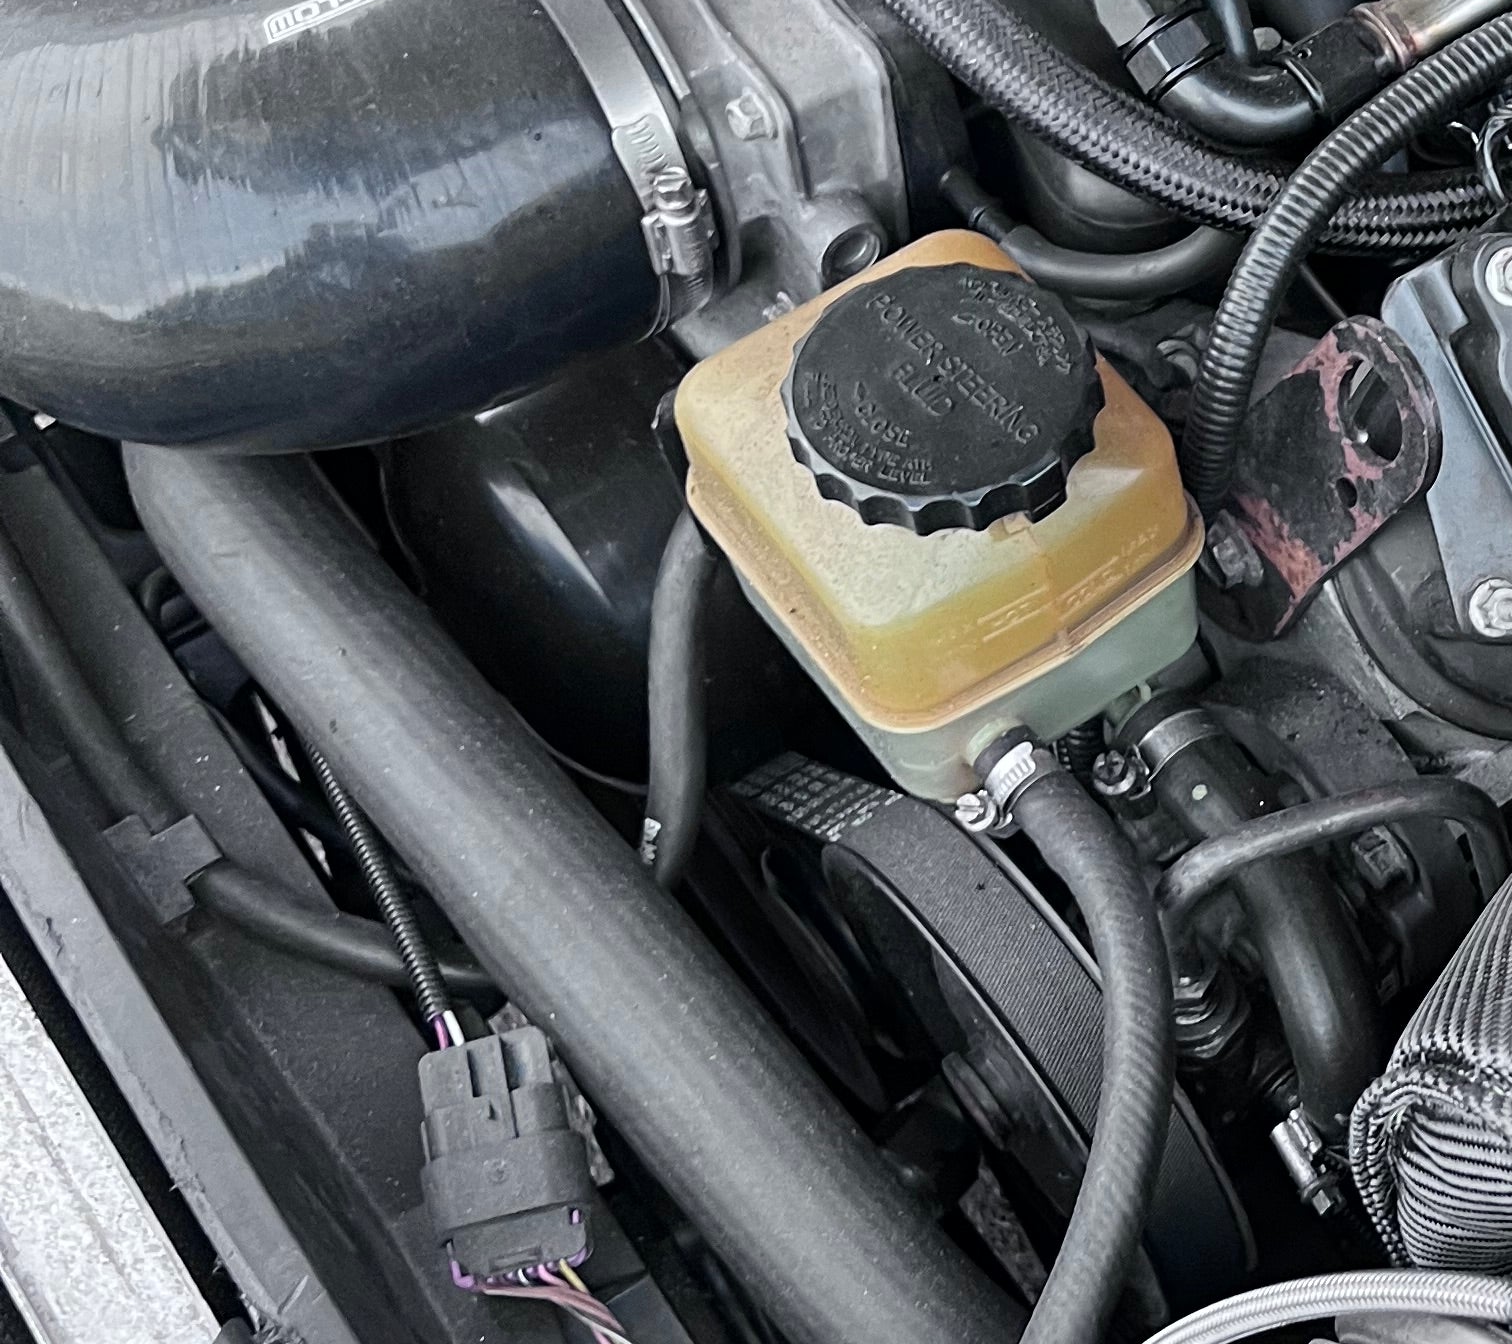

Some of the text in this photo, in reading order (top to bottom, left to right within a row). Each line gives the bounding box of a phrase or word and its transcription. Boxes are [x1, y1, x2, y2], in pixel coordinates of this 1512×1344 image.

[866, 292, 945, 366] POWER
[937, 355, 1039, 445] STEERING
[892, 361, 954, 418] FLUID
[854, 402, 912, 448] CLOSE
[876, 464, 933, 486] LEVEL
